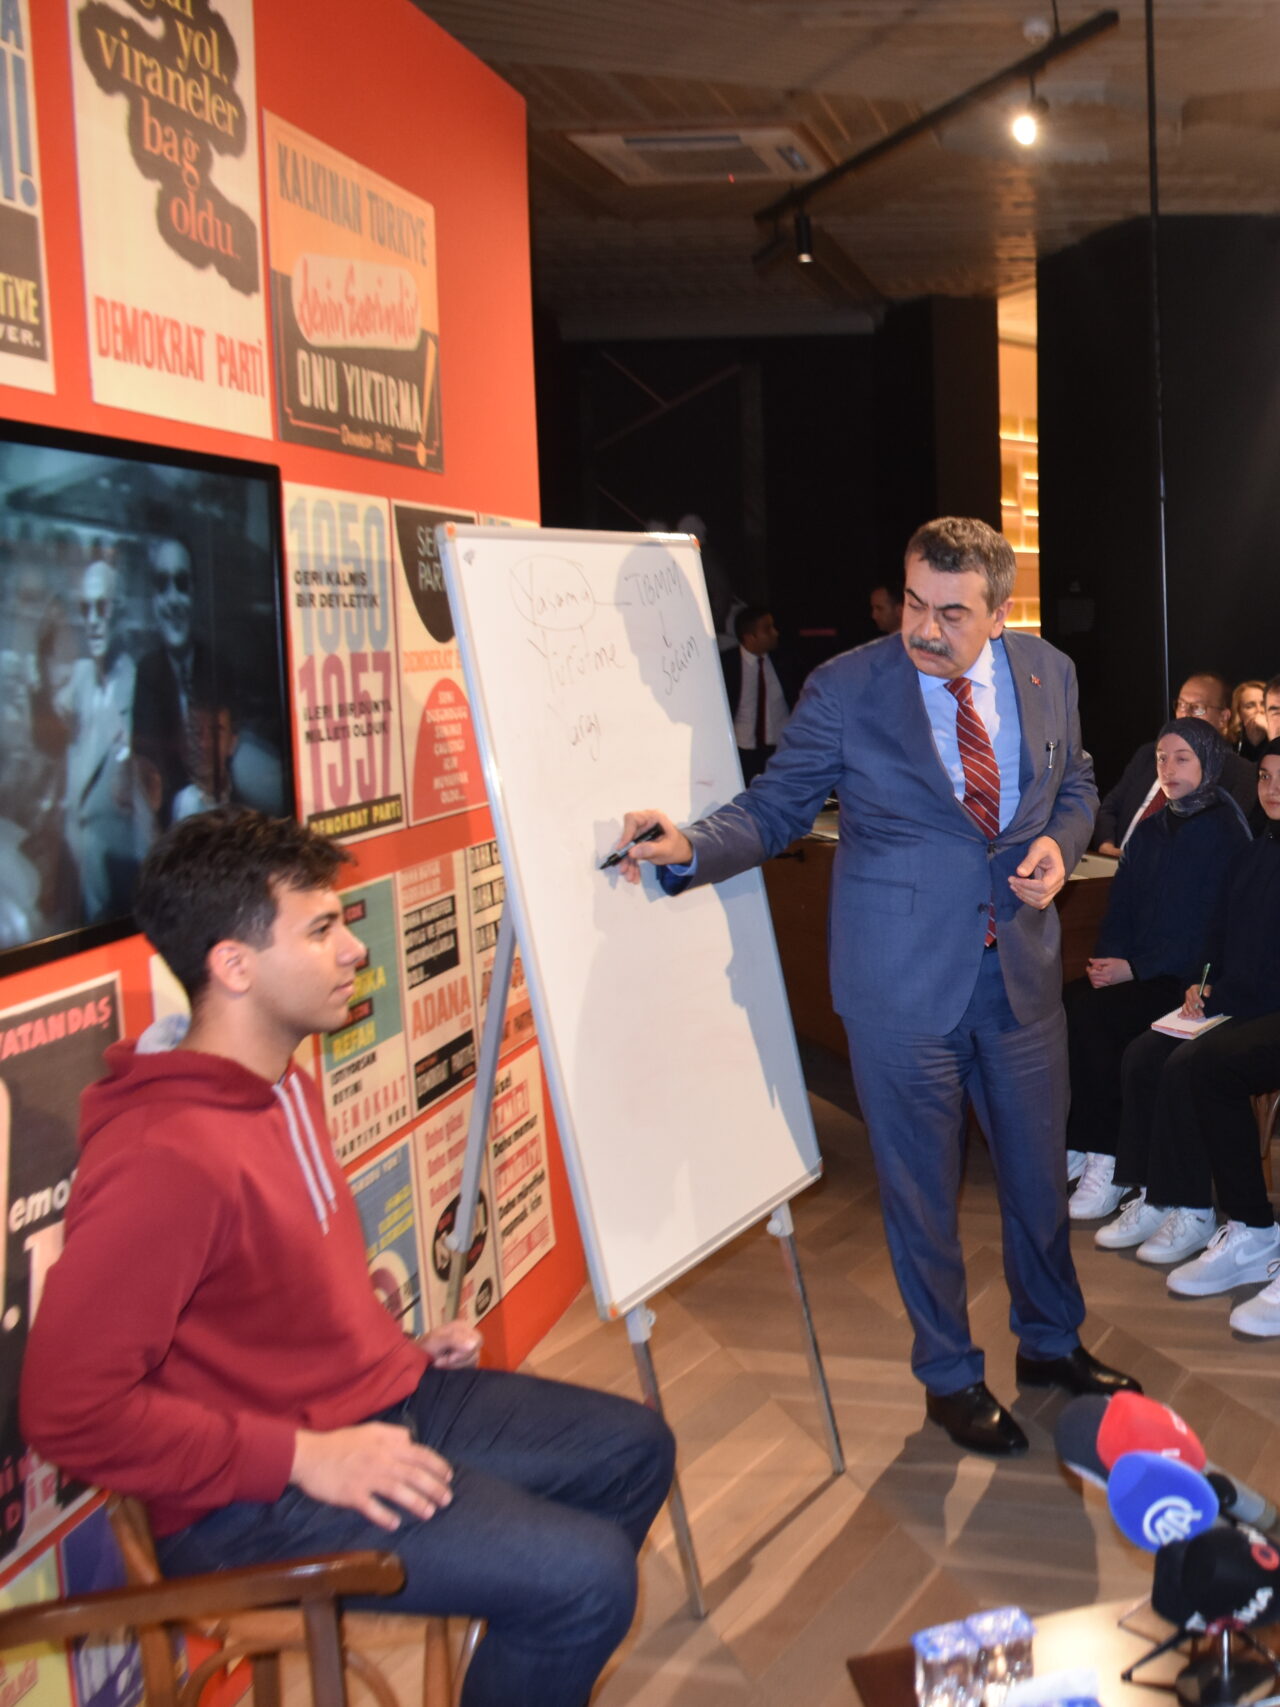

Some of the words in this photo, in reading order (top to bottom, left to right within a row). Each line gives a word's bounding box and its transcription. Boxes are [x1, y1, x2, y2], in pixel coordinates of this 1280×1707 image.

[96, 26, 240, 138] viraneler
[277, 141, 363, 236] KALKINAN
[94, 295, 206, 383] DEMOKRAT
[215, 333, 266, 398] PARTİ
[297, 348, 339, 414] ONU
[289, 496, 389, 656] 1950
[298, 651, 393, 815] 1957
[412, 975, 472, 1040] ADANA
[332, 1074, 407, 1142] DEMOKRAT
